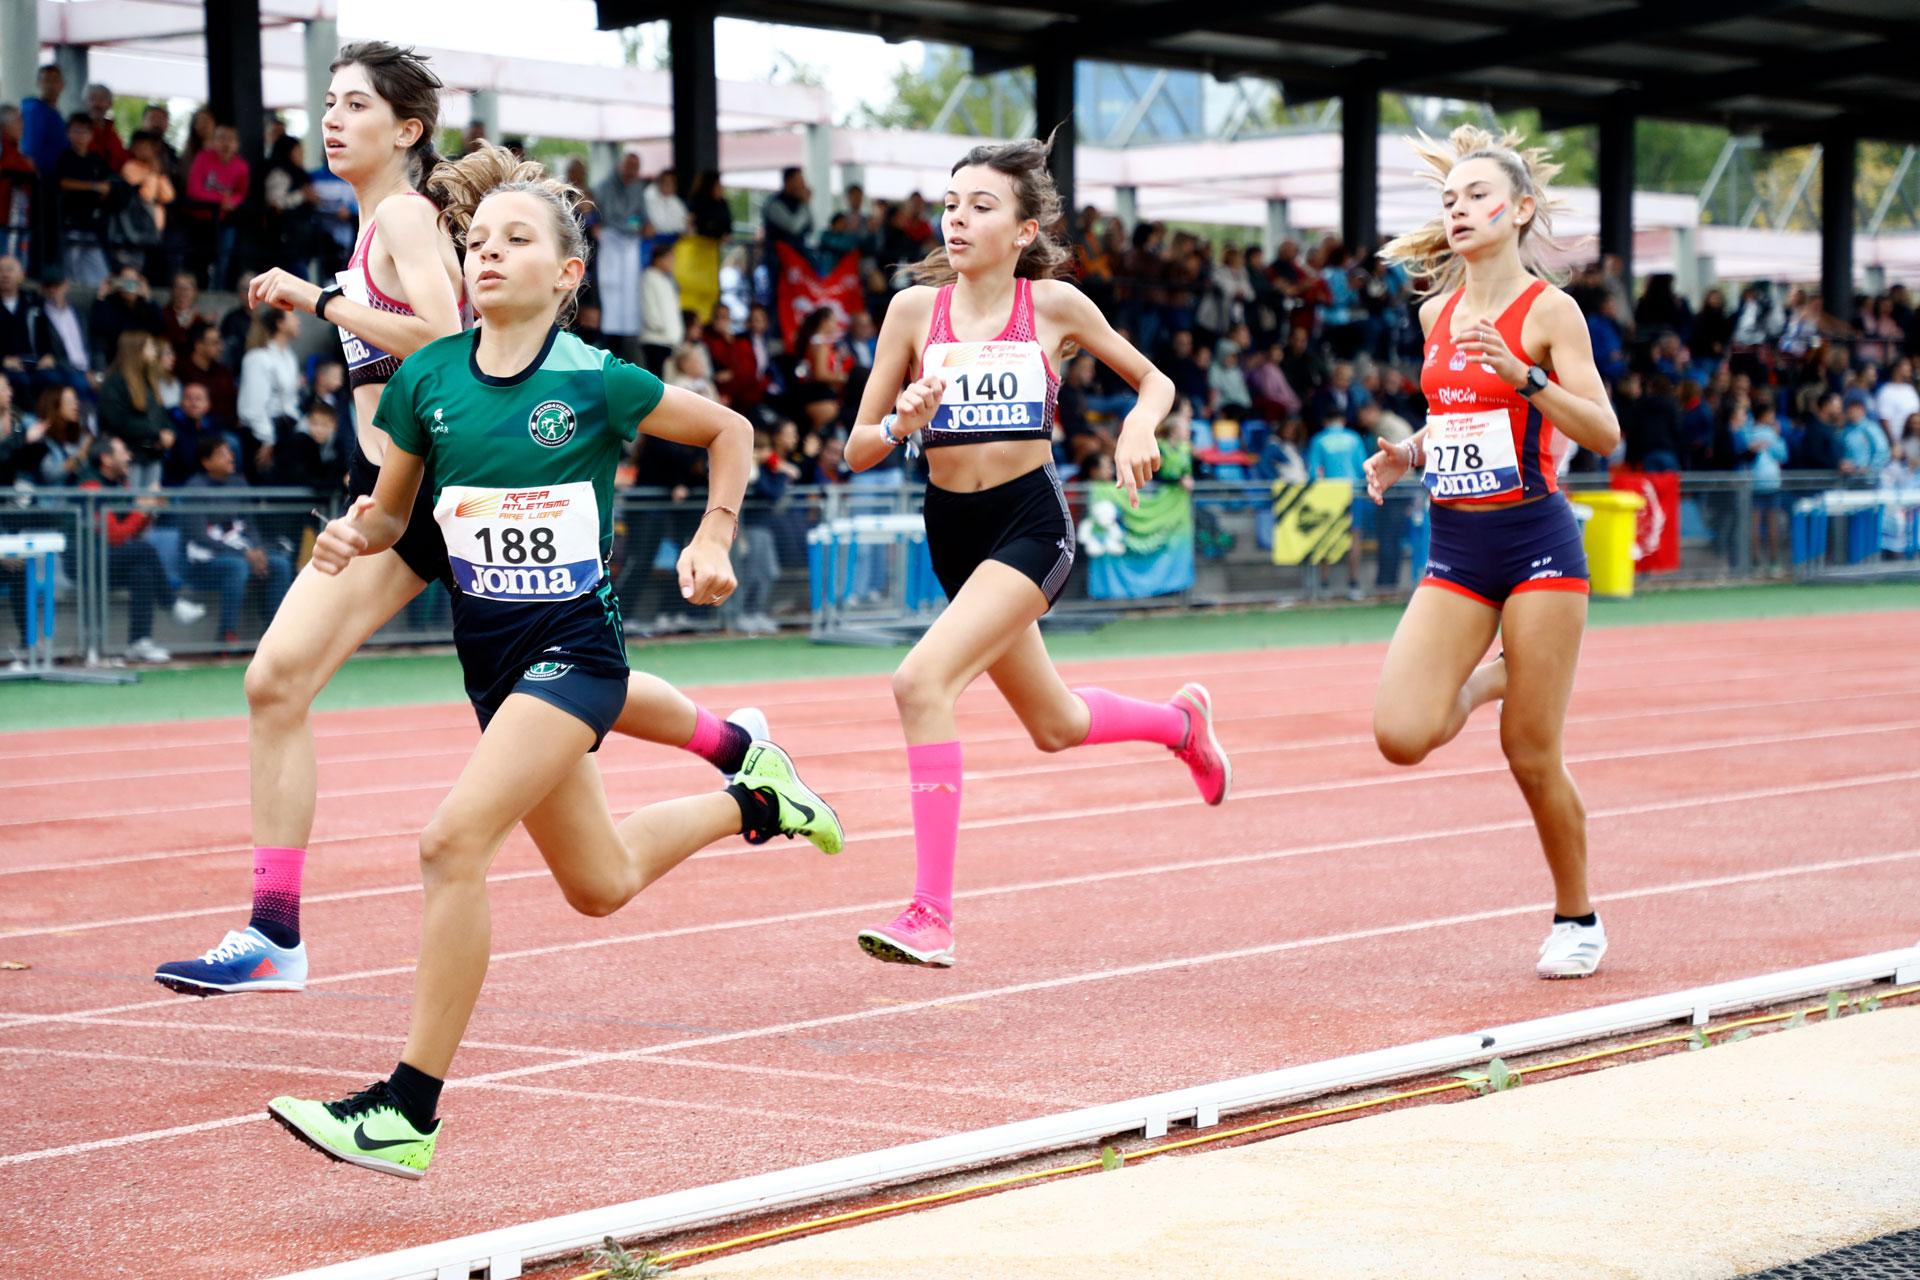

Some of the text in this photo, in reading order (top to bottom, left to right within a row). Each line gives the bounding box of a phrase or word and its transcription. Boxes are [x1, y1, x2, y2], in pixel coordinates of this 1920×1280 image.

[342, 339, 370, 364] oma
[955, 372, 1018, 402] 140
[947, 403, 1030, 429] Joma
[1434, 443, 1483, 471] 278
[501, 499, 570, 511] ATLETISMO
[504, 490, 550, 503] RFEA
[499, 512, 525, 521] AIRE
[474, 527, 557, 564] 188
[471, 565, 576, 595] Joma
